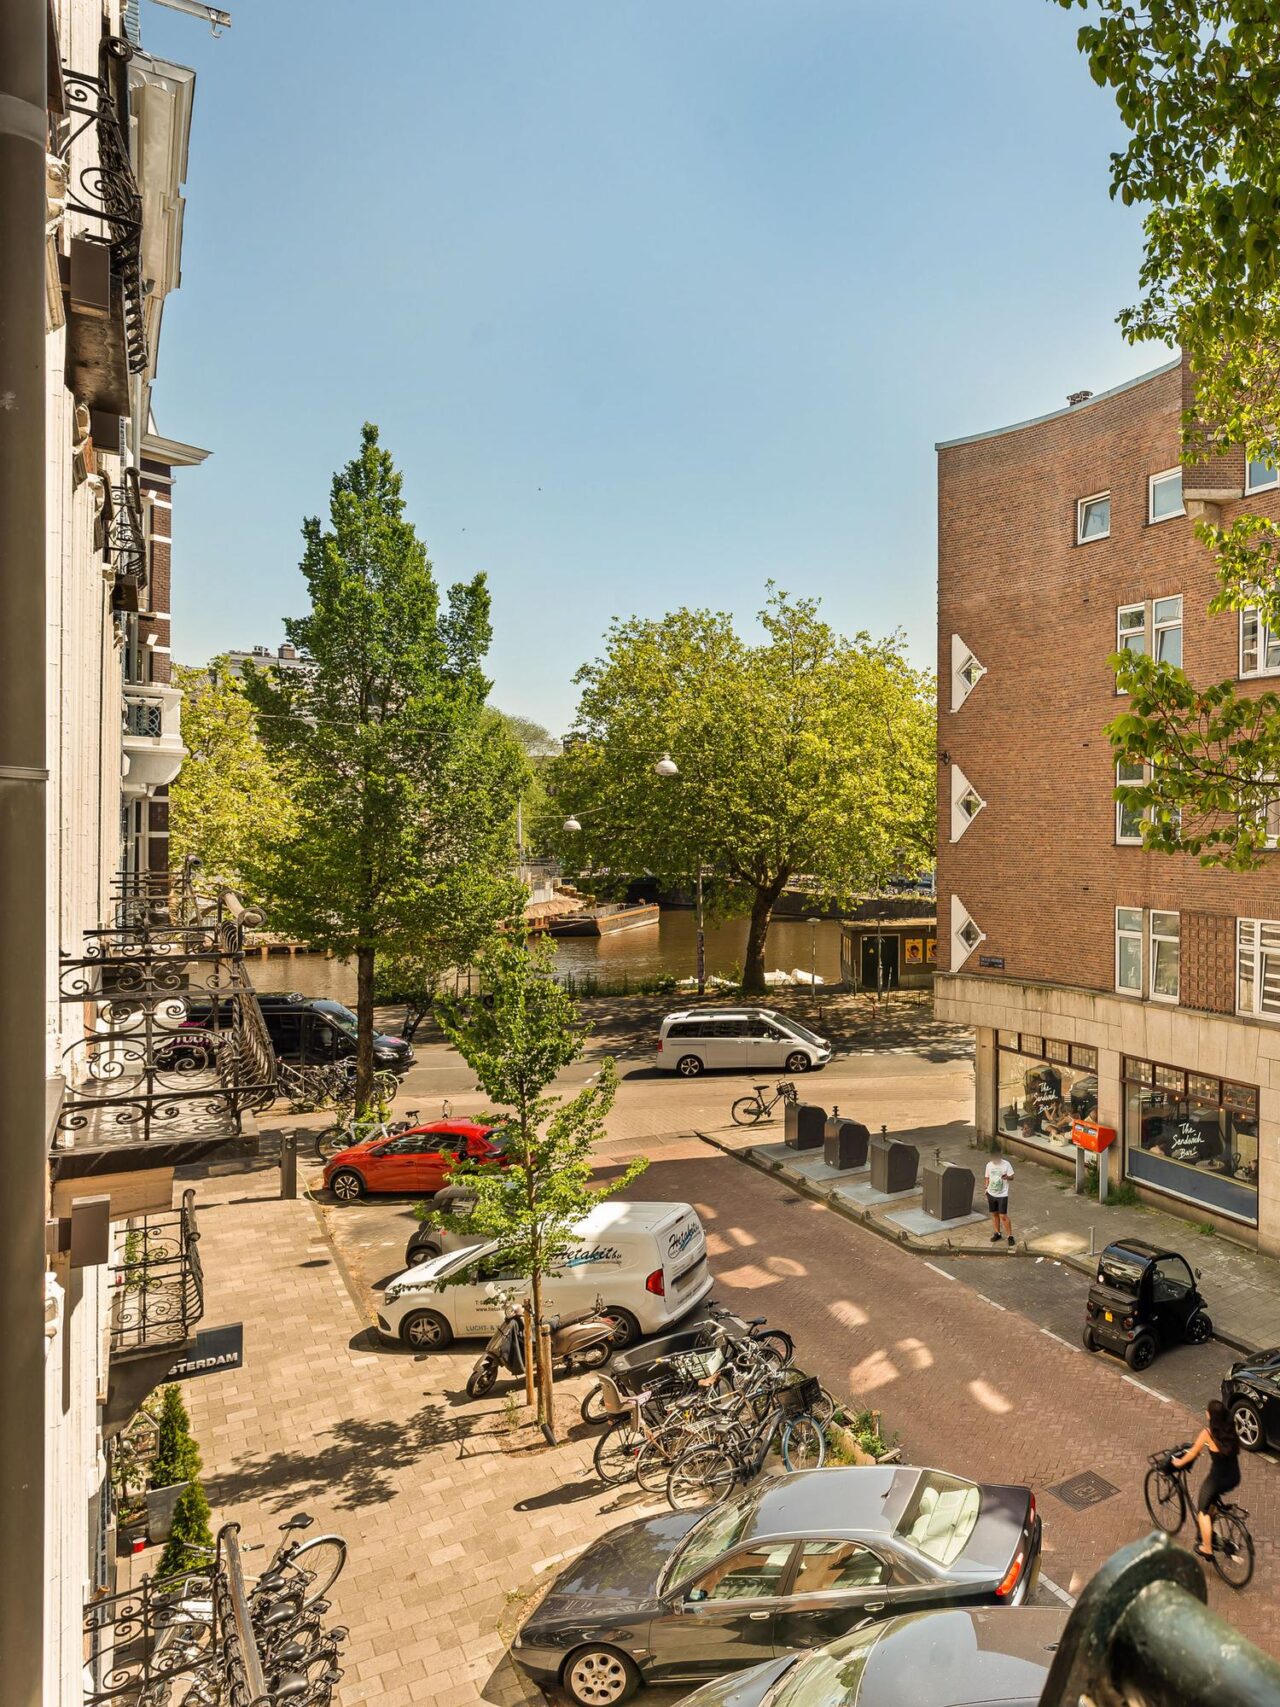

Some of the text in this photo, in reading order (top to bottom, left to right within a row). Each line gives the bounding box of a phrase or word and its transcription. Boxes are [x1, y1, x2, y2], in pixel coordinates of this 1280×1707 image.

[1039, 1082, 1052, 1092] The
[1179, 1122, 1196, 1134] The
[1171, 1131, 1205, 1149] Sandwich
